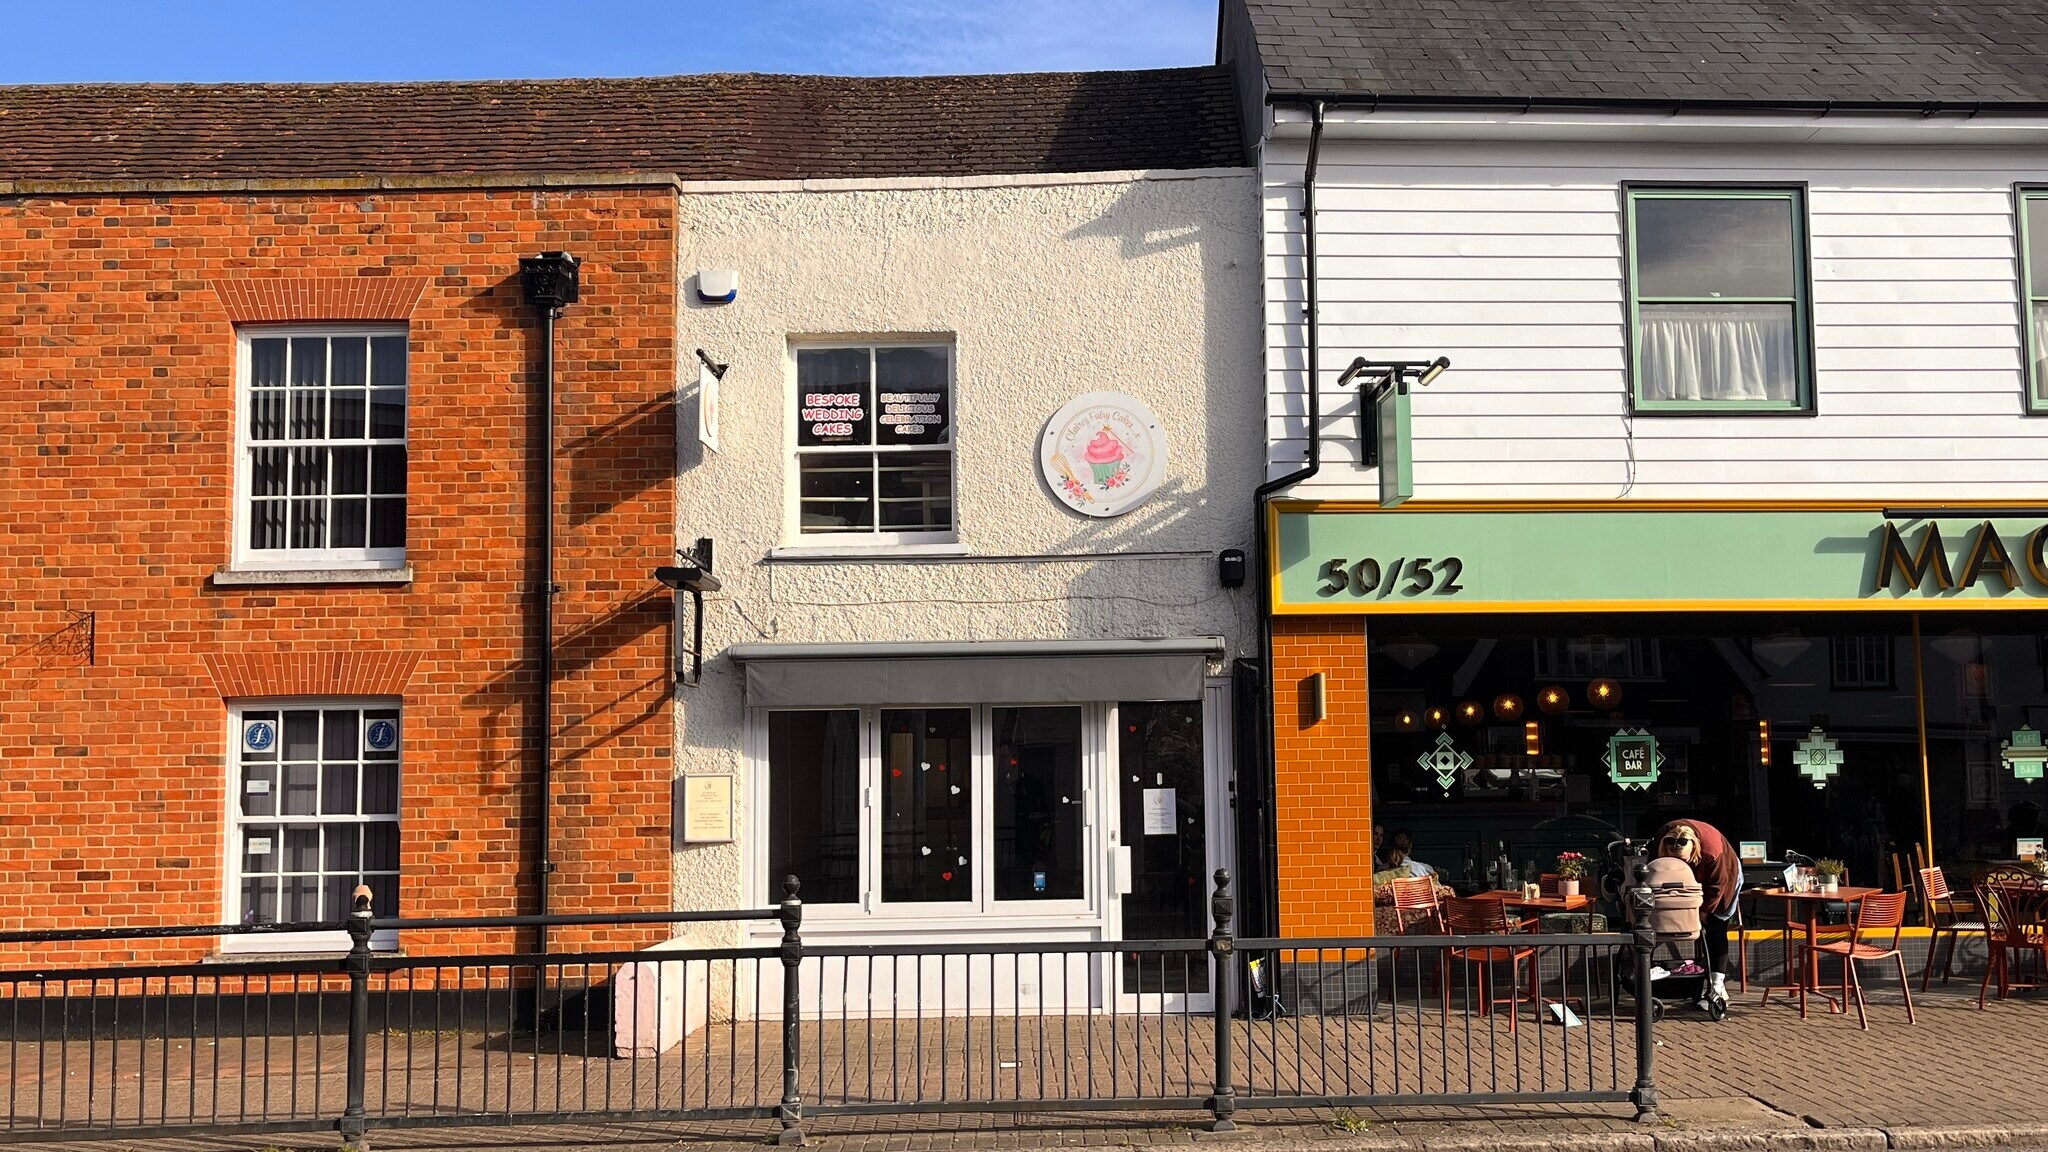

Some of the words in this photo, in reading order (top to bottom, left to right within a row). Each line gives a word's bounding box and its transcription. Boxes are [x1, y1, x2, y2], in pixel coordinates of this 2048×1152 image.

[806, 394, 860, 407] BESPOKE
[880, 393, 940, 403] BEAUTIFULLY
[885, 404, 935, 414] DELICIOUS
[802, 409, 863, 421] WEDDING
[879, 415, 941, 424] CELEBRATION
[1113, 411, 1134, 428] Cakes
[812, 423, 853, 435] CAKES
[895, 425, 925, 434] CAKES
[1326, 557, 1464, 594] 50/52
[1622, 747, 1645, 759] CAFÉ
[1625, 760, 1642, 770] BAR
[2020, 764, 2037, 774] BAR
